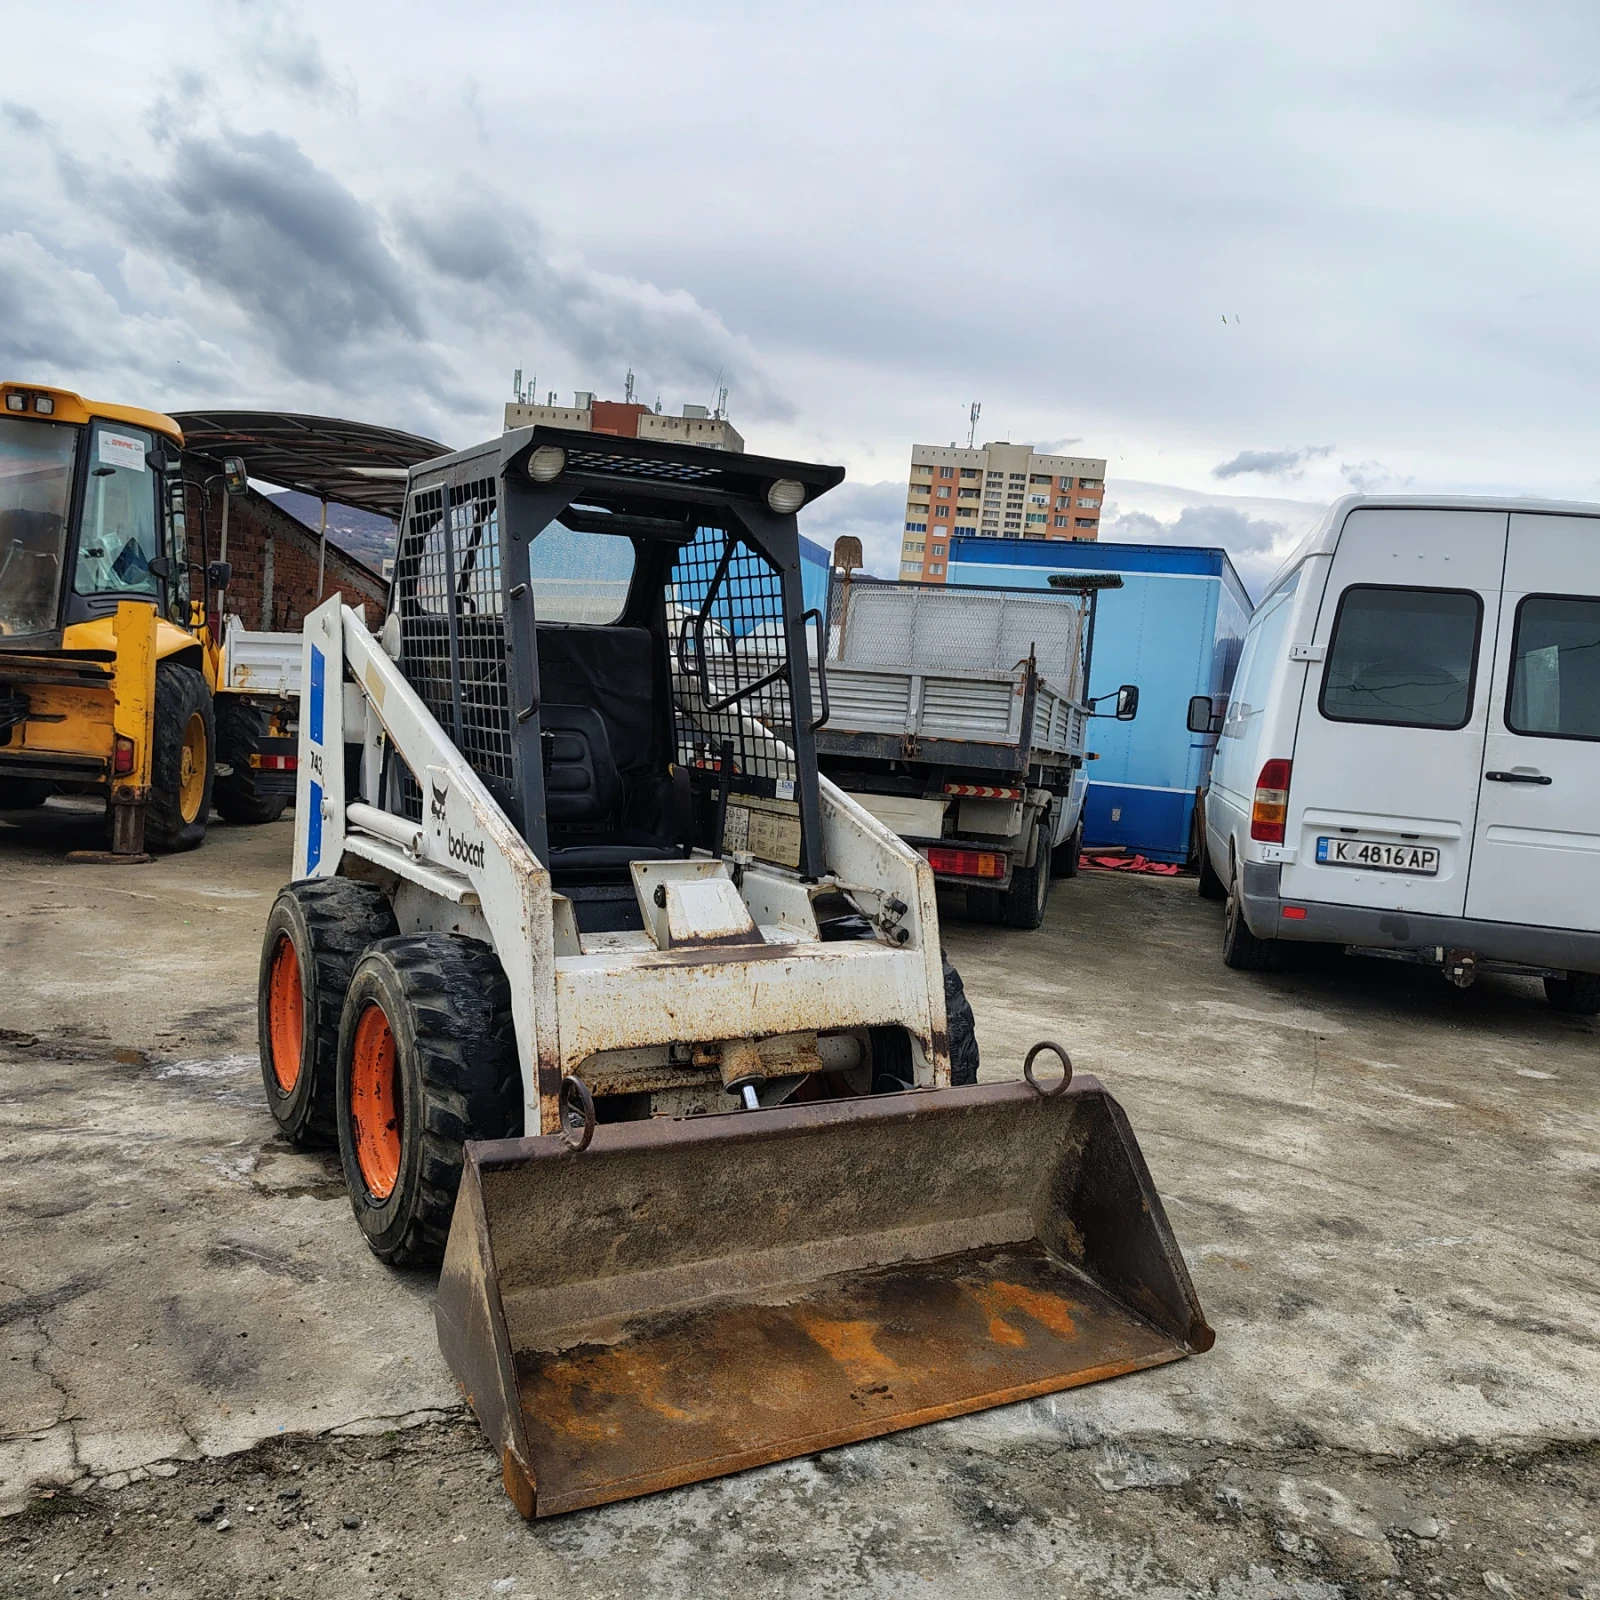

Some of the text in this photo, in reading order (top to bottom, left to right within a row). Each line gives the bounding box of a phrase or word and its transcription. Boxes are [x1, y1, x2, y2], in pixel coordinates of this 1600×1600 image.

[311, 750, 323, 776] 743
[448, 827, 485, 870] bobcat
[1336, 842, 1349, 861] K
[1358, 845, 1404, 865] 4816
[1408, 849, 1435, 868] AP
